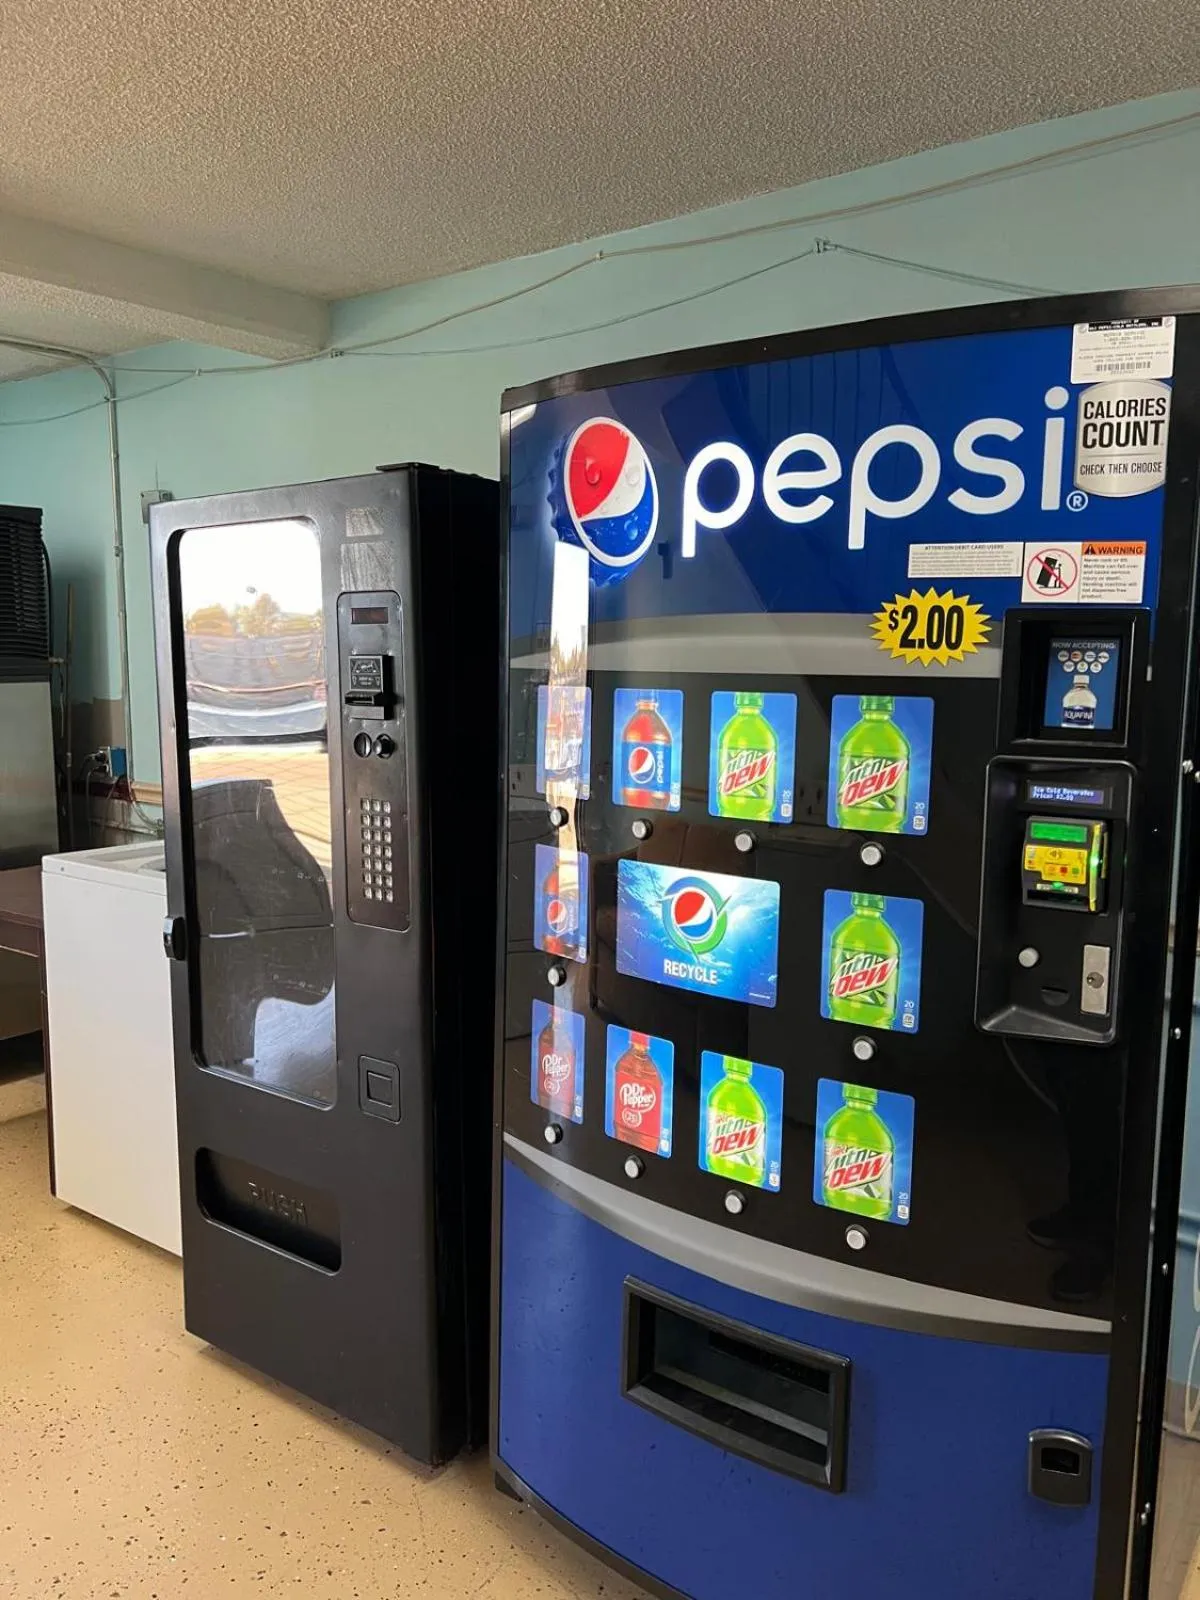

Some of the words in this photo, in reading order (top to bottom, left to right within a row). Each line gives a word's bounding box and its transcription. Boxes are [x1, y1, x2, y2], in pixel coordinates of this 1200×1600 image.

[1083, 397, 1167, 420] CALORIES
[1082, 420, 1165, 449] COUNT
[681, 386, 1071, 558] pepsi
[1080, 463, 1105, 476] CHECK
[1108, 462, 1128, 474] THEN
[1131, 461, 1163, 474] CHOOSE
[1098, 546, 1144, 555] WARNING
[888, 604, 964, 651] $2.00
[1064, 711, 1093, 720] AQUAFINA
[656, 750, 665, 784] pepsi
[1046, 786, 1061, 794] Cold
[663, 958, 718, 985] RECYCLE
[620, 1083, 654, 1109] Pepper
[631, 1083, 646, 1096] Dr
[248, 1180, 309, 1225] PUSH
